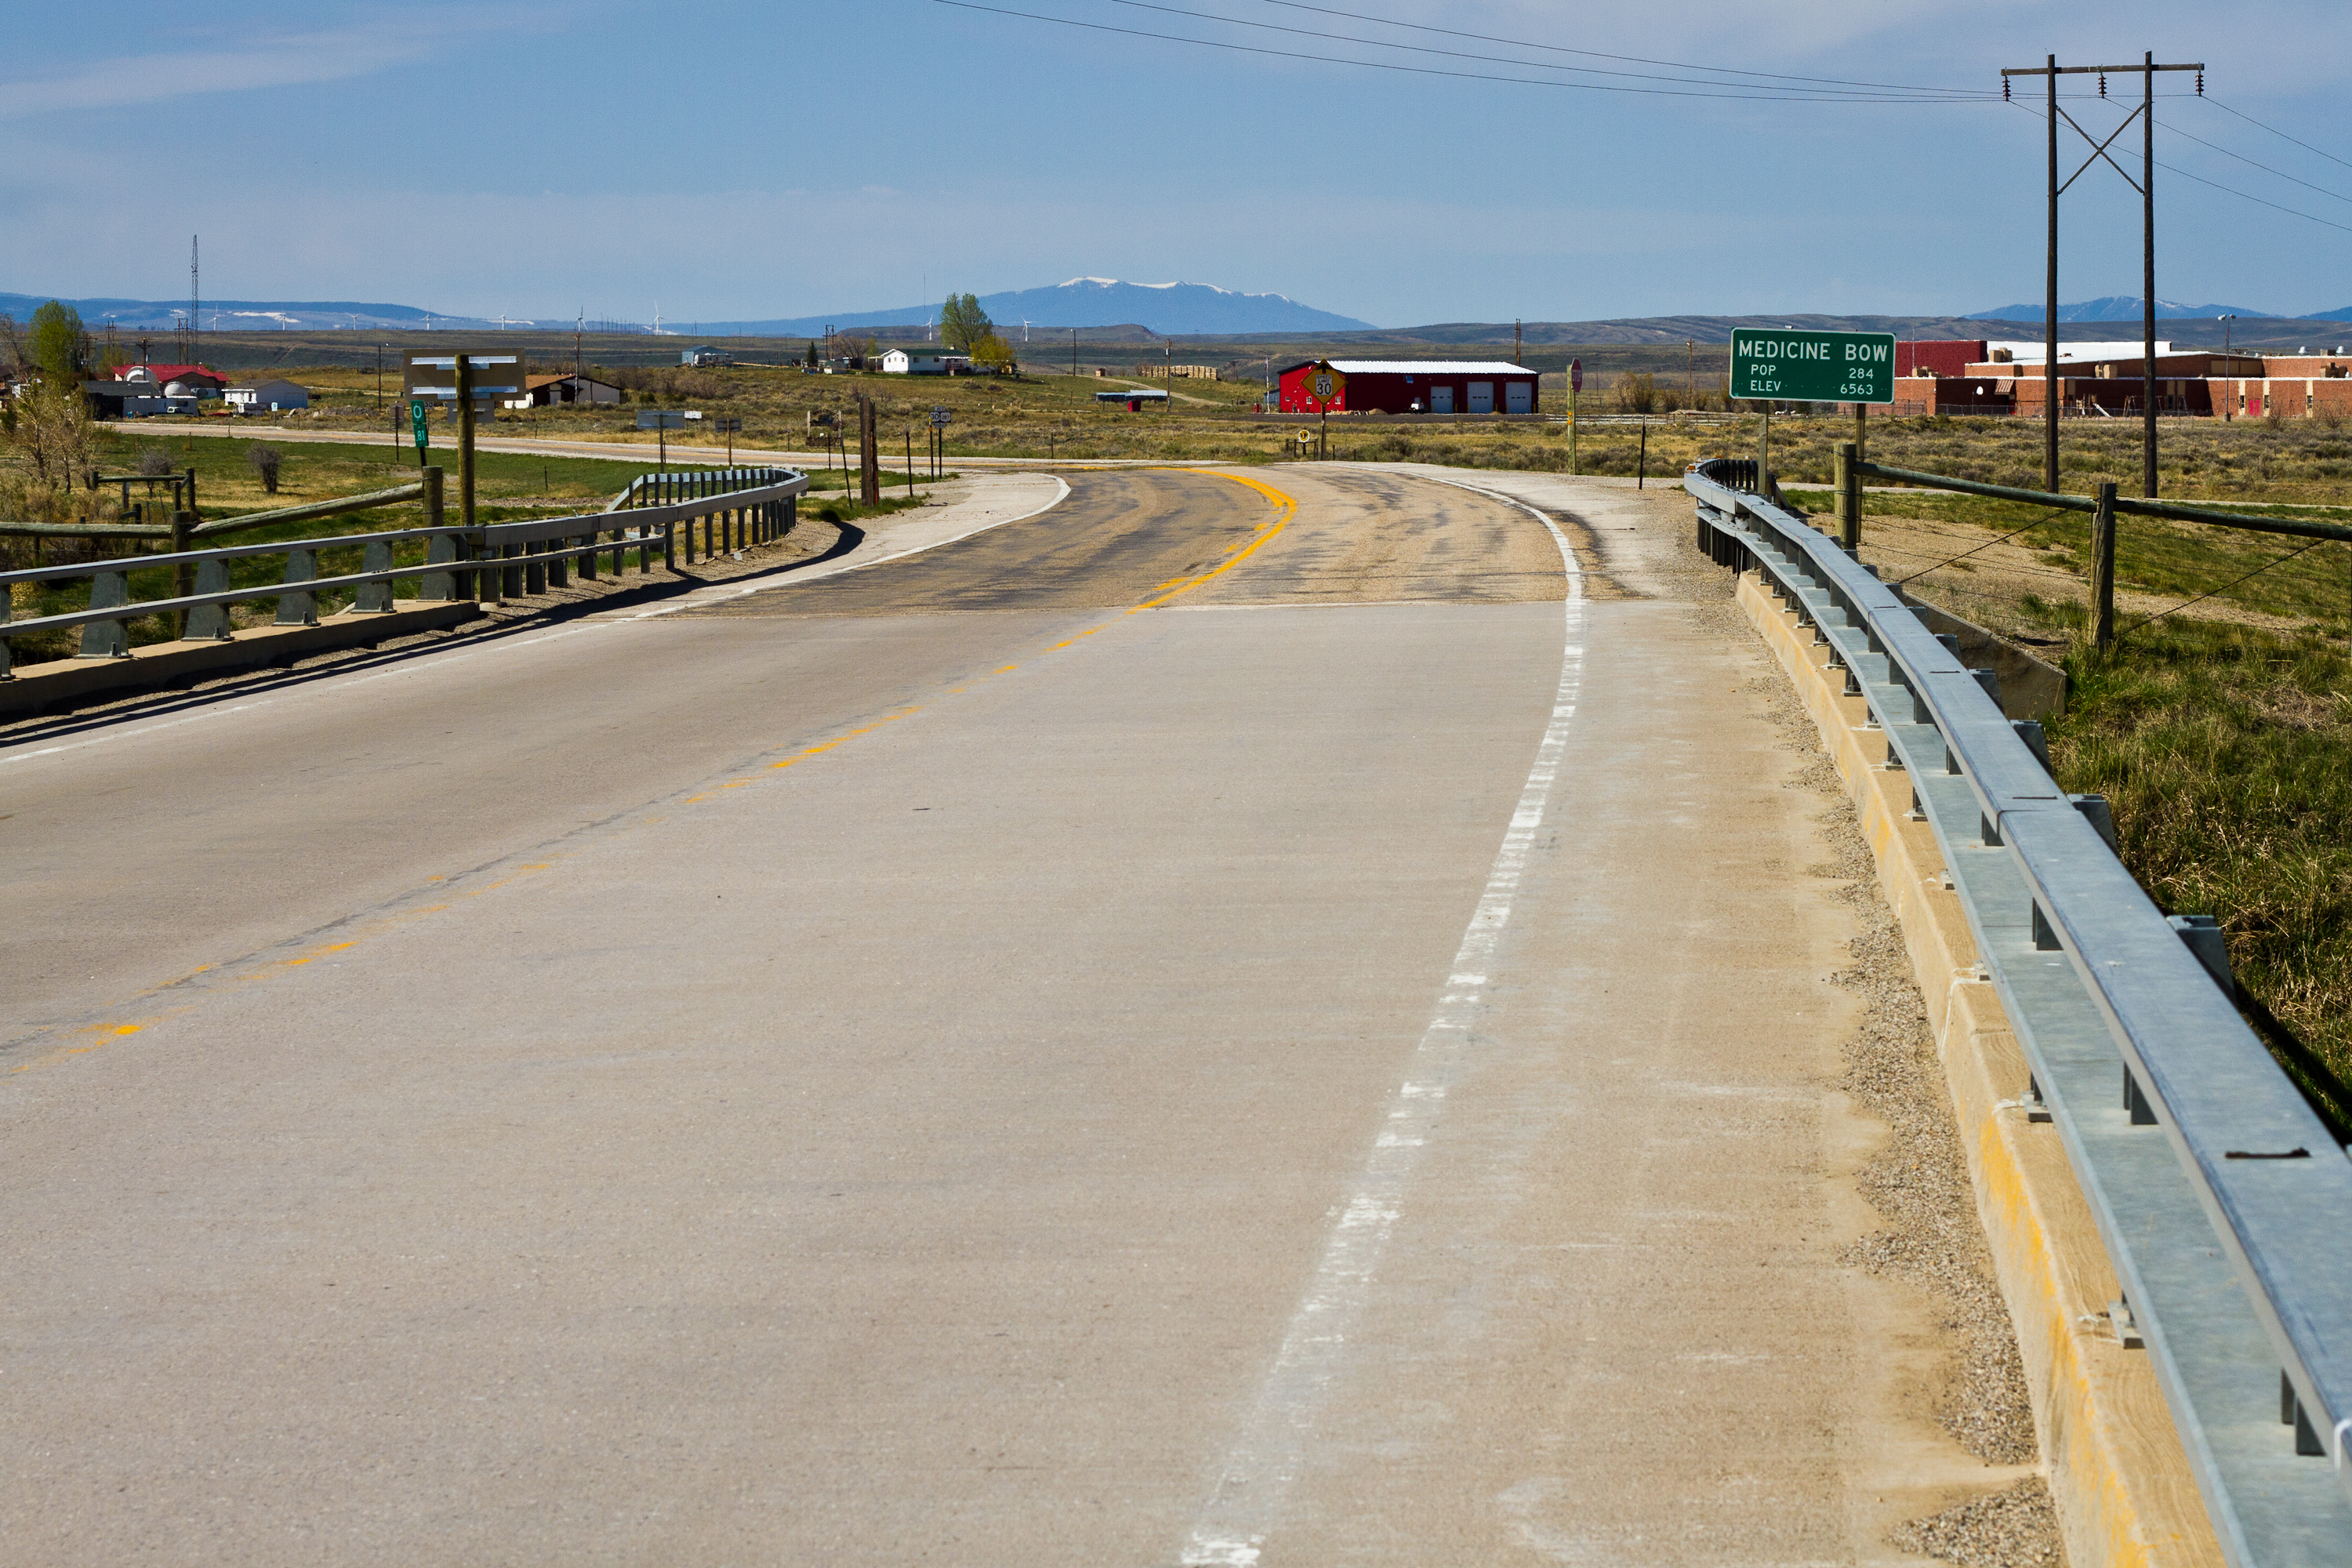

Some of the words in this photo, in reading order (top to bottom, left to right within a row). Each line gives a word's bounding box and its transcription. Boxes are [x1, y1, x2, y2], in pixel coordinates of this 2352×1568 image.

[1739, 339, 1831, 360] MEDICINE
[1845, 343, 1888, 362] BOW
[1572, 369, 1582, 382] STOP
[1751, 364, 1777, 376] POP
[1849, 368, 1874, 379] 284
[1317, 383, 1331, 394] 30
[1750, 380, 1781, 392] ELEV
[1840, 383, 1874, 395] 6563
